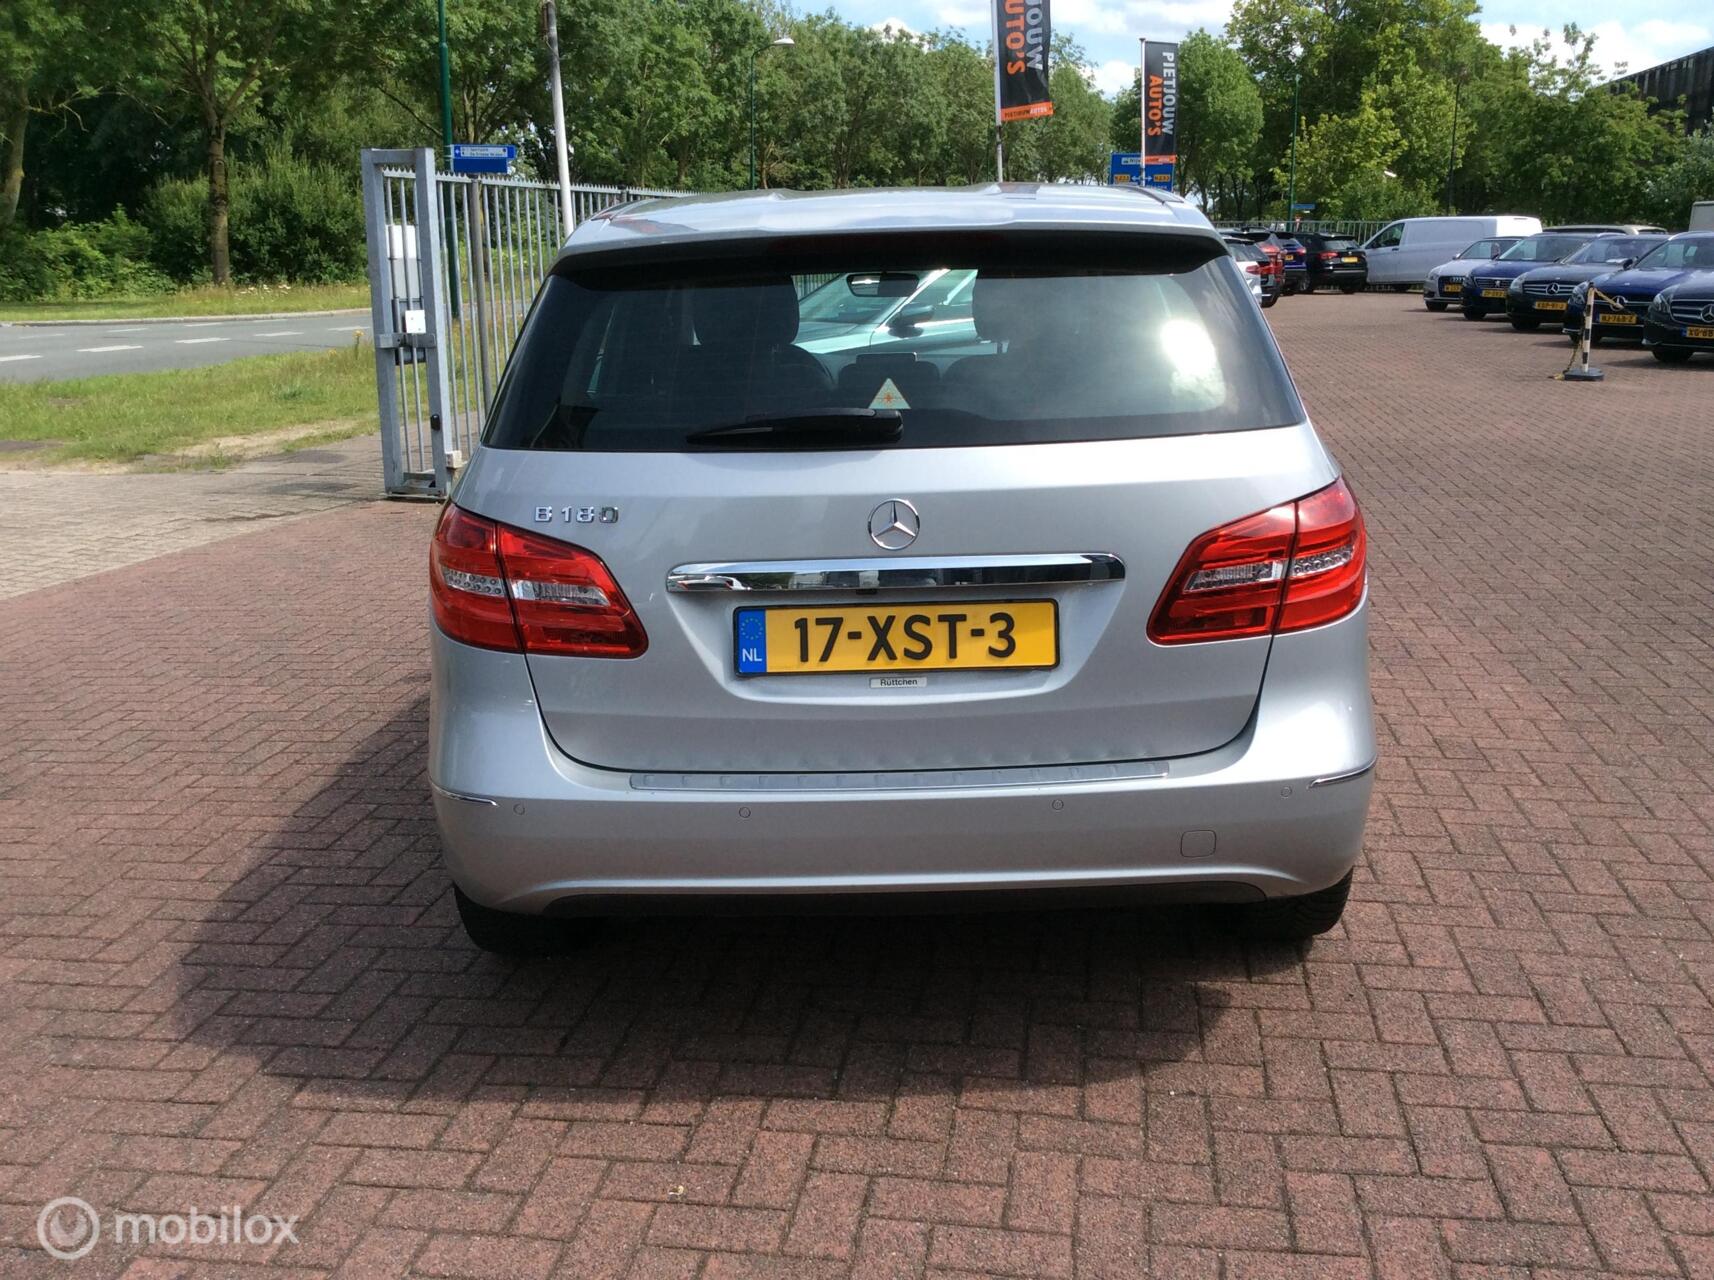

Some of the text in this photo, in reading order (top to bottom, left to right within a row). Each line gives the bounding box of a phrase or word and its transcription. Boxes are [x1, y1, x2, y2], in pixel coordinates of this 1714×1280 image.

[1147, 74, 1163, 136] AUTO'S
[1162, 51, 1176, 135] PIETJOUW
[535, 506, 619, 523] B 180
[742, 612, 1017, 664] NL 17-XST-3
[880, 677, 918, 688] Rüttchen
